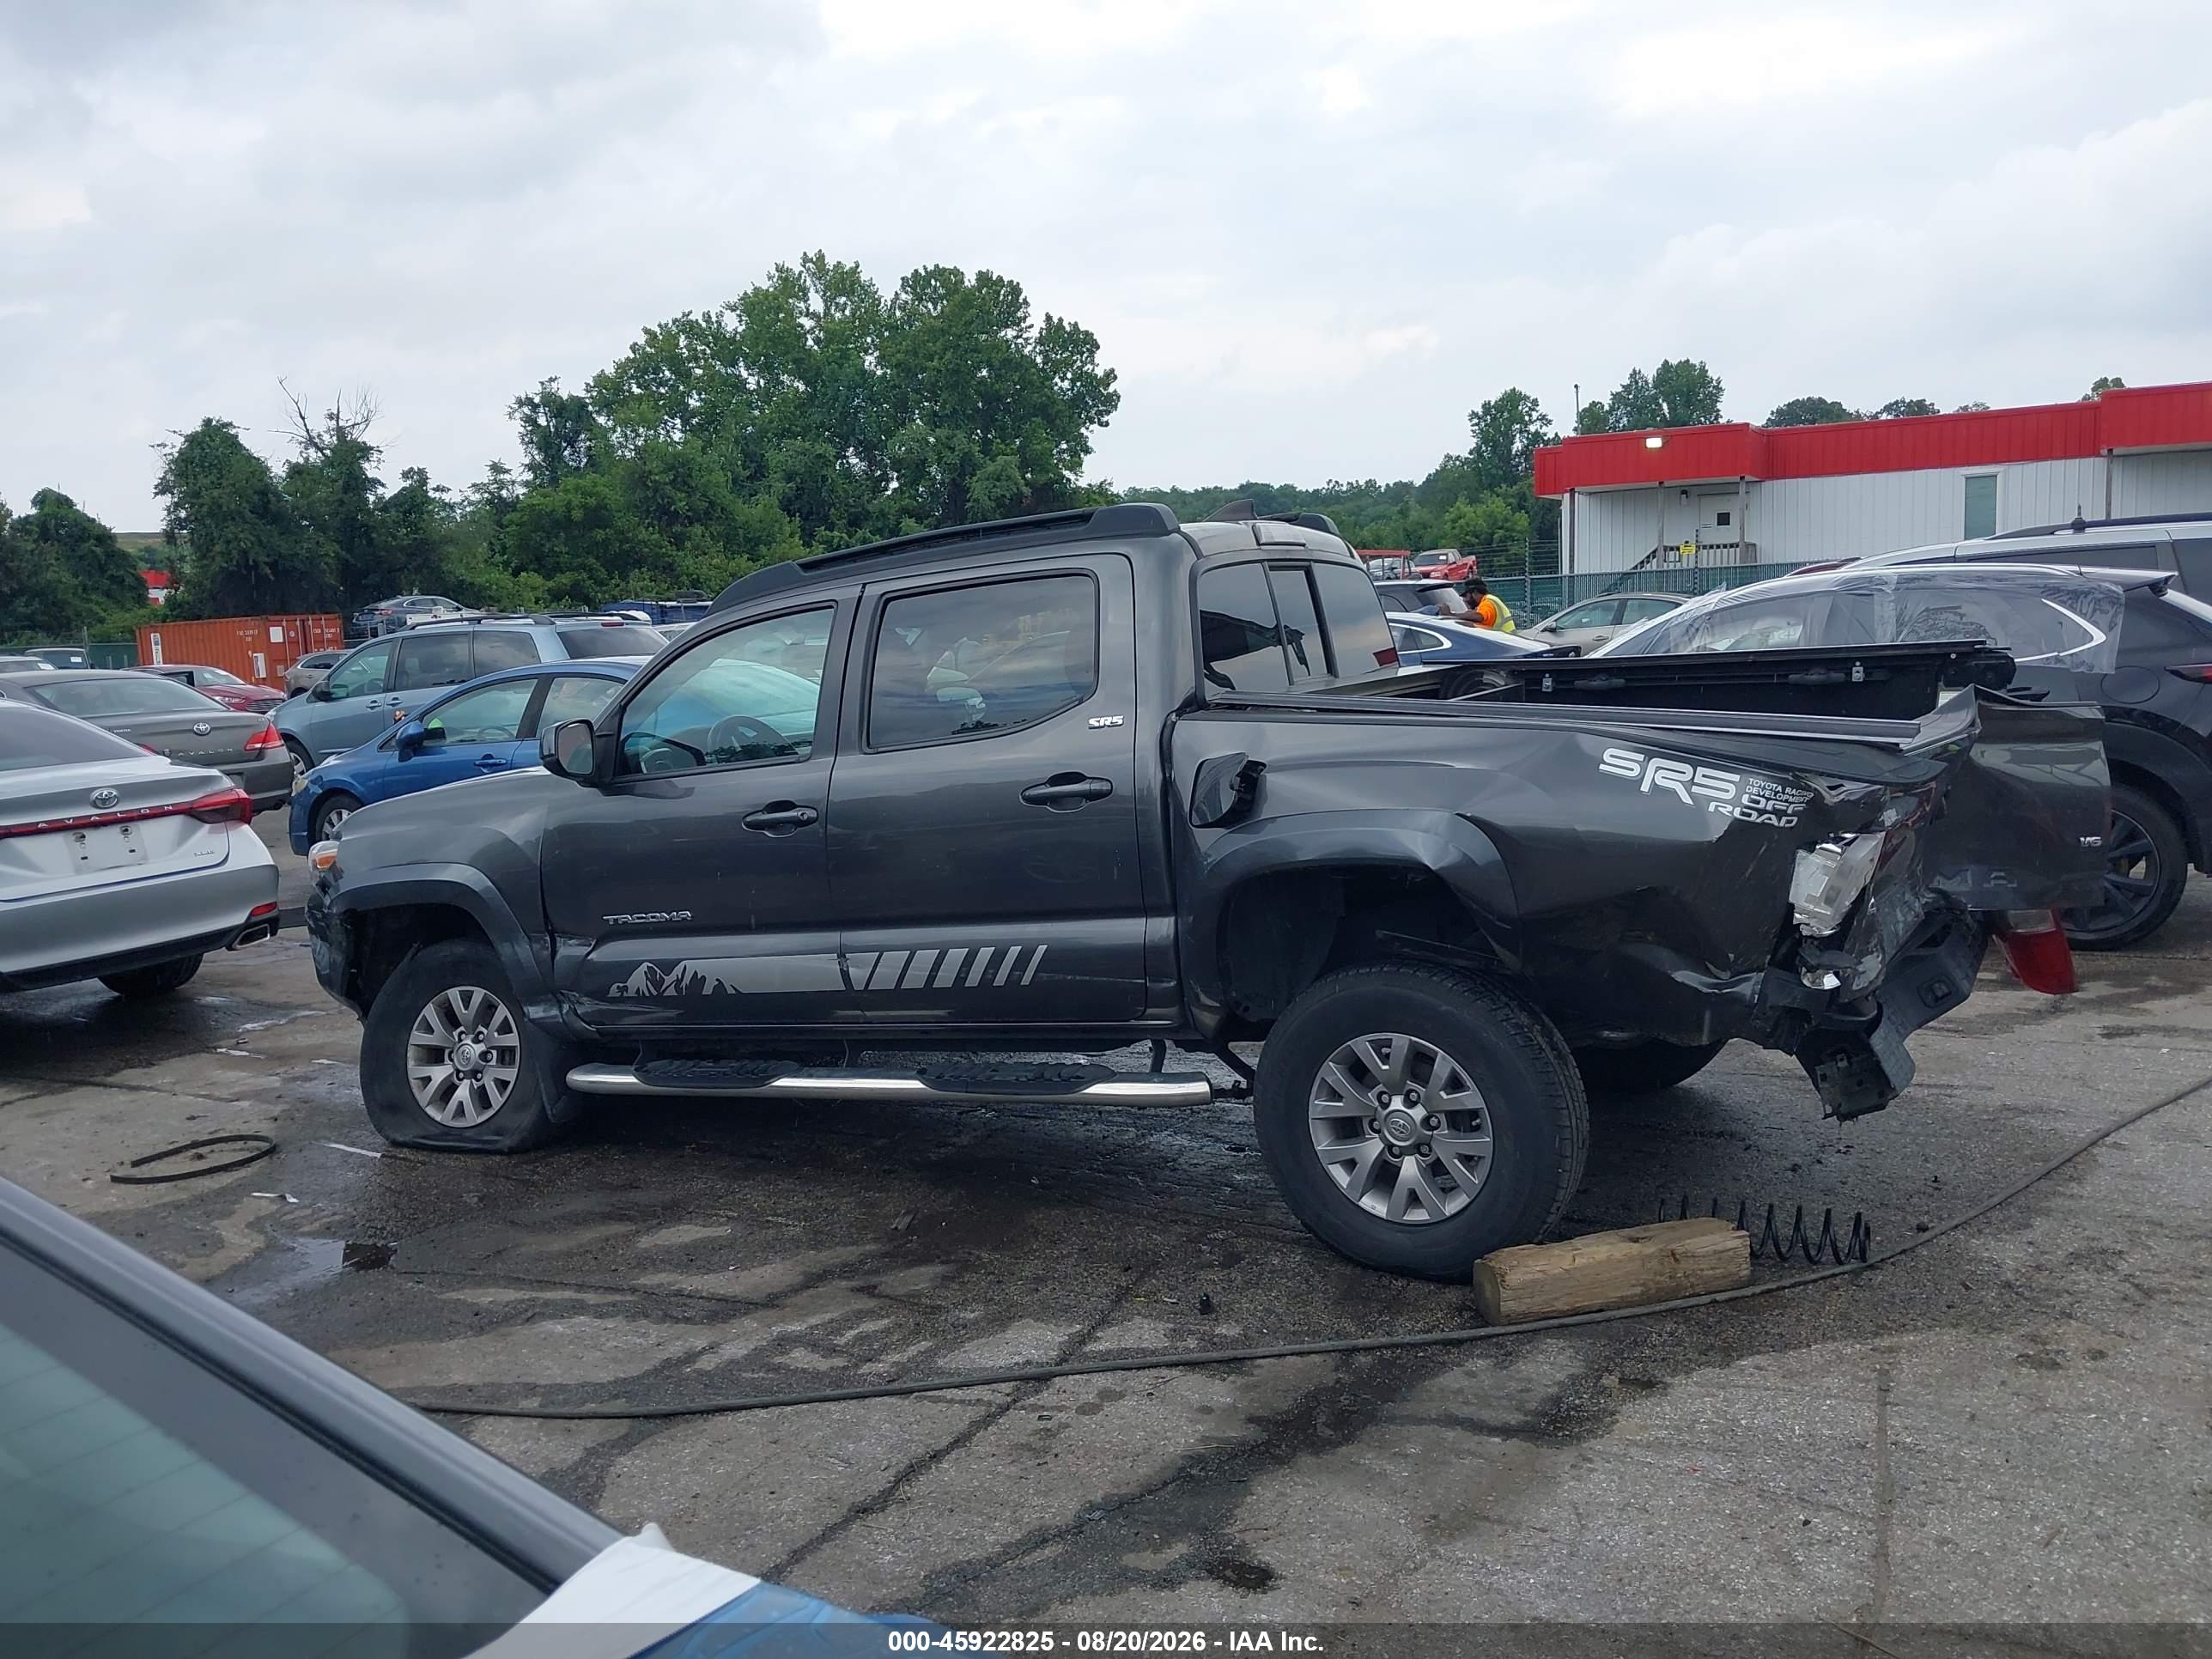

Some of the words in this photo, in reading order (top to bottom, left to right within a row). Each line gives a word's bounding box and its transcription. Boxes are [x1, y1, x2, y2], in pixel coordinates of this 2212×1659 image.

[1088, 715, 1125, 728] SR5
[178, 748, 234, 757] AVALON
[1598, 747, 1741, 805] SR5
[1745, 786, 1811, 804] DEVELOPMENT
[1747, 777, 1783, 793] TOYOTA
[1784, 786, 1814, 799] RACING
[1741, 793, 1807, 814] OFF
[37, 805, 173, 829] AVALON
[1708, 801, 1799, 828] ROAD
[603, 910, 692, 925] TACOMA
